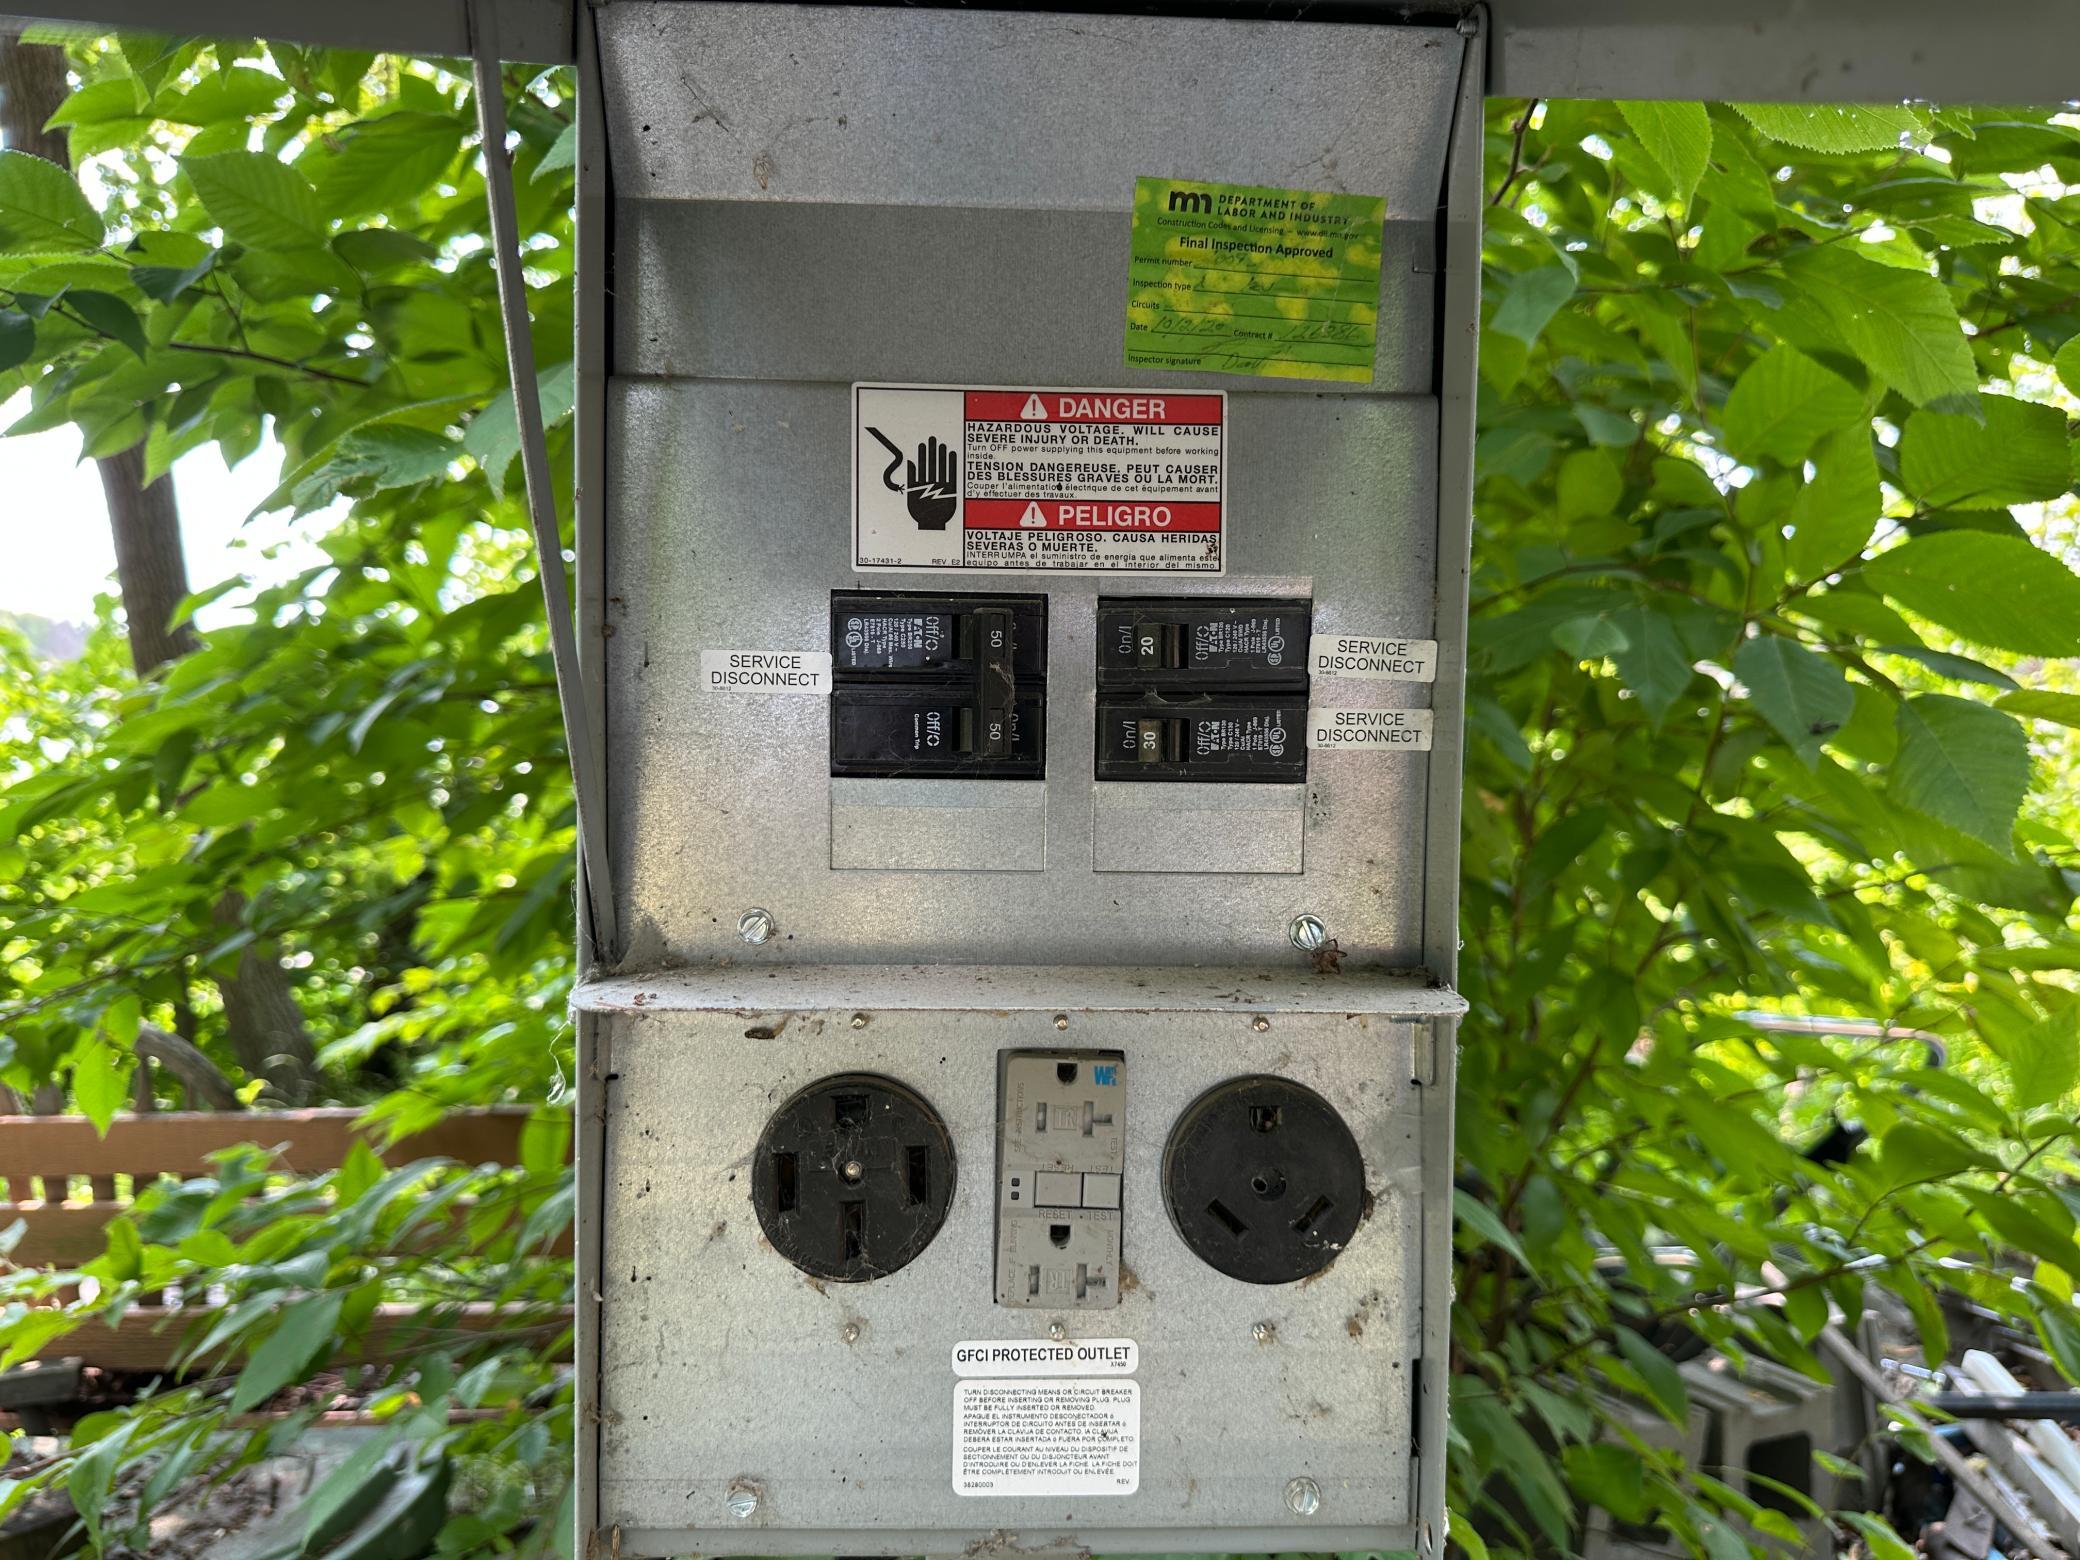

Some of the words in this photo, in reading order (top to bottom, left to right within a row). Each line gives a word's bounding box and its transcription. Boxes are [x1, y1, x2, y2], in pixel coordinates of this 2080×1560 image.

[1218, 194, 1296, 208] DEPARTMENT
[1300, 201, 1315, 210] OF
[1217, 207, 1255, 218] LABOR
[1260, 210, 1285, 220] AND
[1289, 212, 1349, 225] INDUSTRY
[1156, 216, 1206, 228] Construction
[1207, 220, 1231, 232] Codes
[1232, 223, 1247, 232] and
[1180, 236, 1208, 248] Final
[1211, 238, 1272, 255] Inspection
[1275, 243, 1333, 258] Approved
[1134, 255, 1160, 264] Permit
[1161, 258, 1192, 266] number
[1132, 278, 1172, 288] Inspection
[1174, 282, 1191, 291] type
[1131, 299, 1160, 310] Circuits
[1130, 322, 1148, 331] Date
[1233, 329, 1265, 339] Contract
[1128, 353, 1163, 364] Inspector
[1165, 356, 1201, 366] signature
[1059, 398, 1165, 419] DANGER
[967, 422, 1050, 433] HAZARDOUS
[1059, 424, 1124, 434] VOLTAGE.
[1132, 425, 1164, 435] WILL
[1173, 426, 1221, 437] CAUSE
[967, 433, 1015, 443] SEVERE
[1020, 434, 1066, 444] INJURY
[1071, 435, 1088, 444] OR
[1093, 435, 1138, 445] DEATH.
[1011, 445, 1038, 453] power
[1040, 445, 1083, 454] supplying
[1106, 447, 1152, 455] equipment
[1155, 446, 1181, 454] before
[1184, 447, 1221, 457] working
[967, 462, 1023, 471] TENSION
[1030, 462, 1120, 473] DANGEREUSE.
[1126, 464, 1159, 473] PEUT
[1165, 464, 1217, 474] CAUSER
[967, 471, 992, 480] DES
[997, 471, 1072, 482] BLESSURES
[1077, 472, 1128, 483] GRAVES
[1134, 473, 1151, 483] OU
[1157, 474, 1172, 483] LA
[1178, 474, 1217, 484] MORT.
[966, 482, 998, 490] Couper
[1065, 483, 1107, 492] électrique
[1141, 484, 1192, 493] équipement
[1195, 485, 1220, 494] avant
[966, 489, 980, 497] d'y
[983, 489, 1021, 497] effectuer
[1024, 490, 1040, 498] des
[1058, 505, 1171, 526] PELIGRO
[966, 530, 1021, 540] VOLTAJE
[1028, 531, 1106, 542] PELIGROSO.
[1112, 533, 1155, 542] CAUSA
[1161, 533, 1216, 544] HERIDAS
[966, 540, 1023, 551] SEVERAS
[1028, 542, 1036, 551] O
[1041, 542, 1097, 552] MUERTE.
[966, 551, 1026, 559] INTERRUMPA
[1041, 552, 1086, 562] suministro
[1104, 553, 1136, 562] energía
[1159, 553, 1195, 561] alimenta
[966, 560, 999, 568] equipo
[1052, 560, 1087, 568] trabajar
[1185, 561, 1219, 569] mismo.
[991, 630, 1002, 648] 50
[1141, 636, 1154, 656] 20
[1337, 639, 1408, 656] SERVICE
[729, 654, 800, 668] SERVICE
[1318, 655, 1424, 673] DISCONNECT
[711, 671, 819, 686] DISCONNECT
[1335, 712, 1404, 726] SERVICE
[989, 723, 1001, 740] 50
[1317, 728, 1422, 742] DISCONNECT
[1143, 731, 1156, 750] 30
[1038, 1209, 1072, 1219] RESET
[1087, 1211, 1114, 1221] TEST
[956, 1348, 988, 1362] GFCI
[992, 1347, 1073, 1362] PROTECTED
[1077, 1346, 1130, 1360] OUTLET
